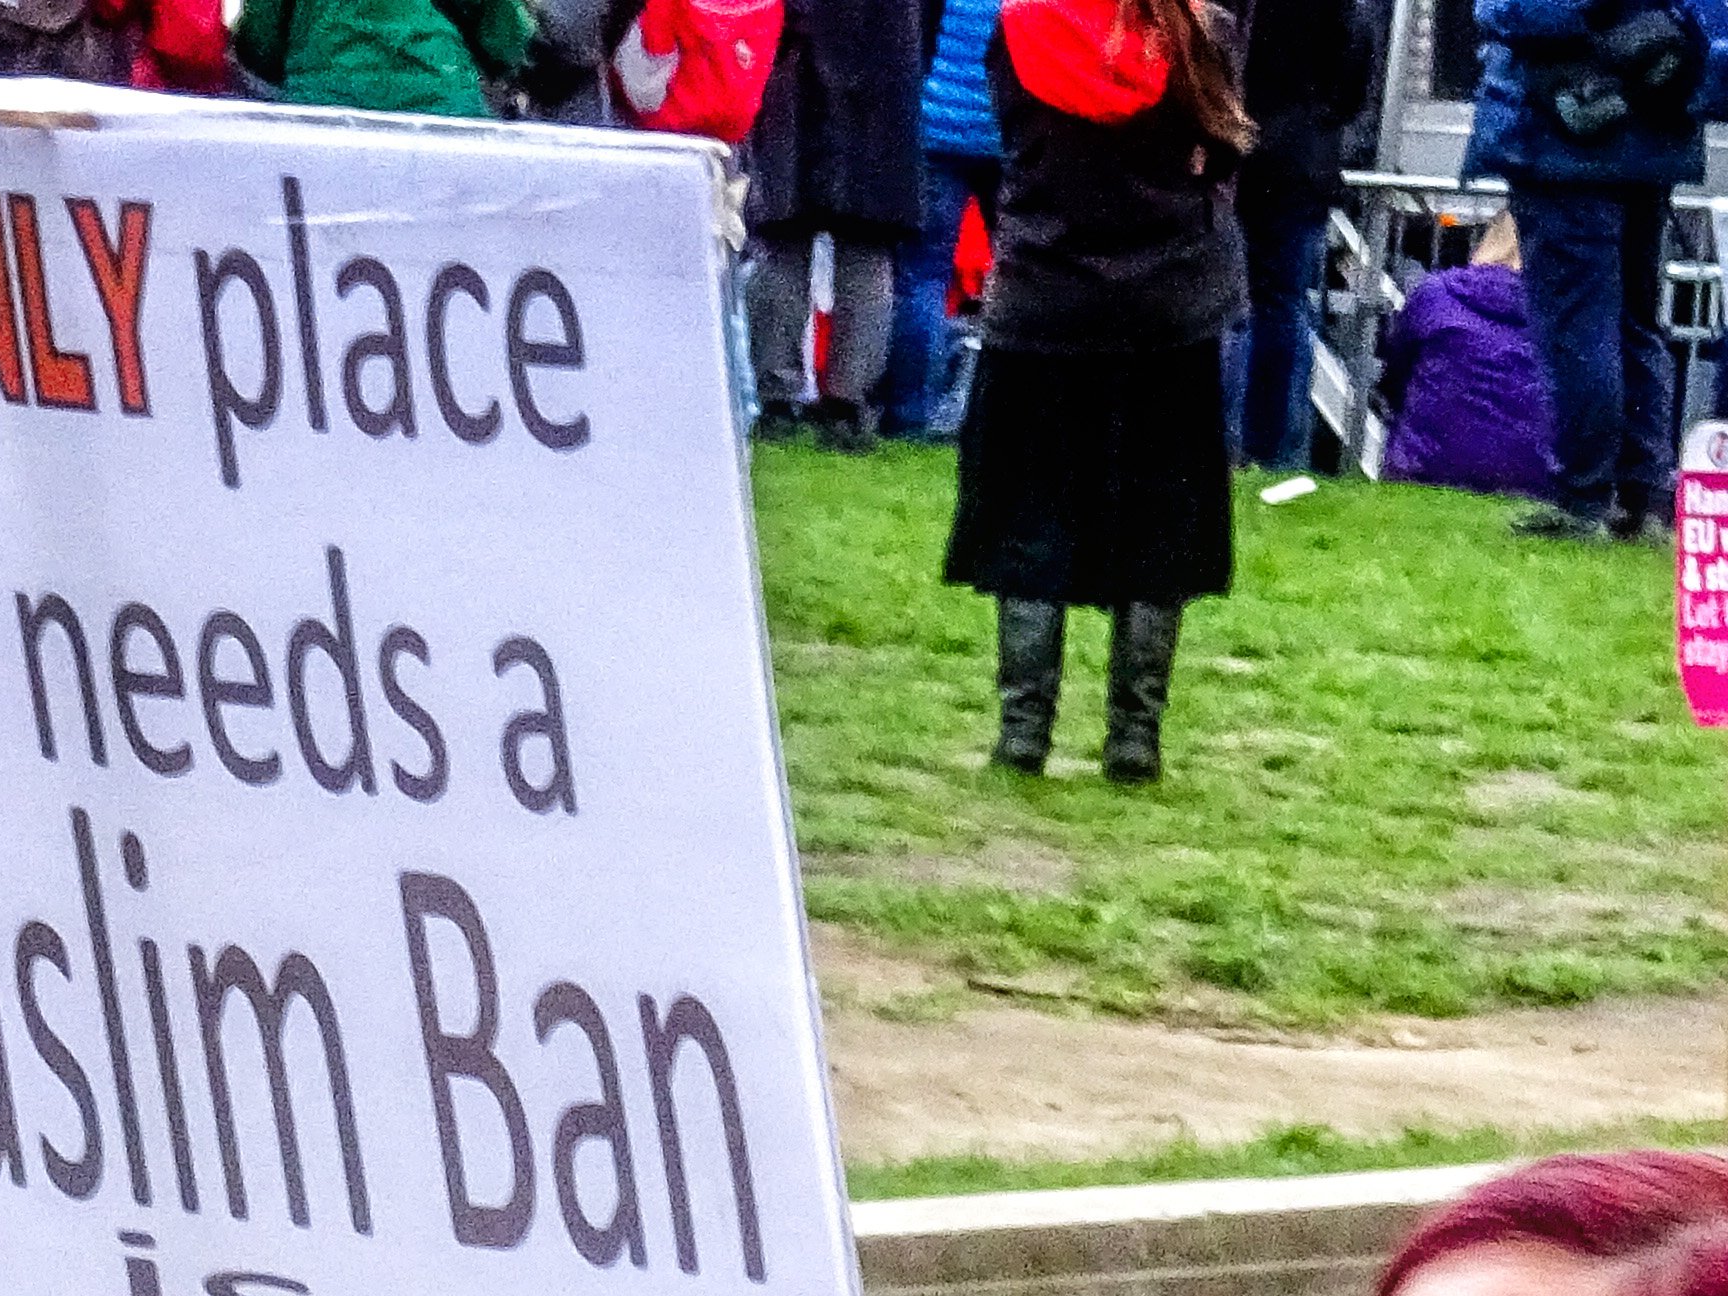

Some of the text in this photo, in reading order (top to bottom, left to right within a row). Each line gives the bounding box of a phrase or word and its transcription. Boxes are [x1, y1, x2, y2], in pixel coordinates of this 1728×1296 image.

[192, 174, 591, 490] place
[1682, 518, 1714, 553] EU
[1683, 593, 1720, 628] Let
[14, 545, 448, 803] needs
[492, 636, 578, 815] a
[398, 870, 765, 1282] Ban
